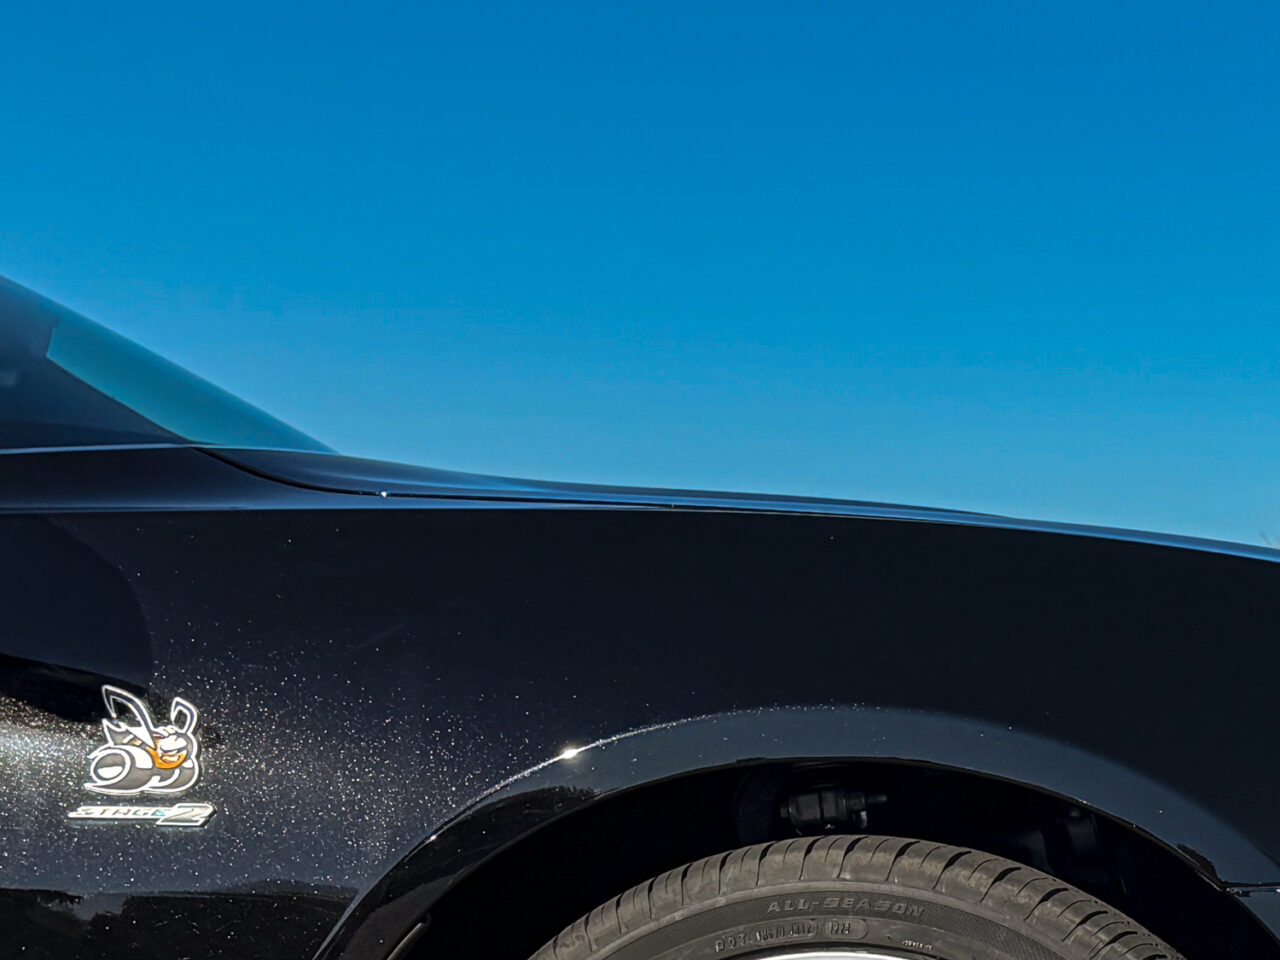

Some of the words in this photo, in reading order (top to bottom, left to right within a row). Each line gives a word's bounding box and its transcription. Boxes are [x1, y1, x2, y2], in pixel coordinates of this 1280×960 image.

[75, 807, 168, 817] STAGE
[157, 803, 217, 826] 2
[767, 897, 925, 918] ALL-SEASON
